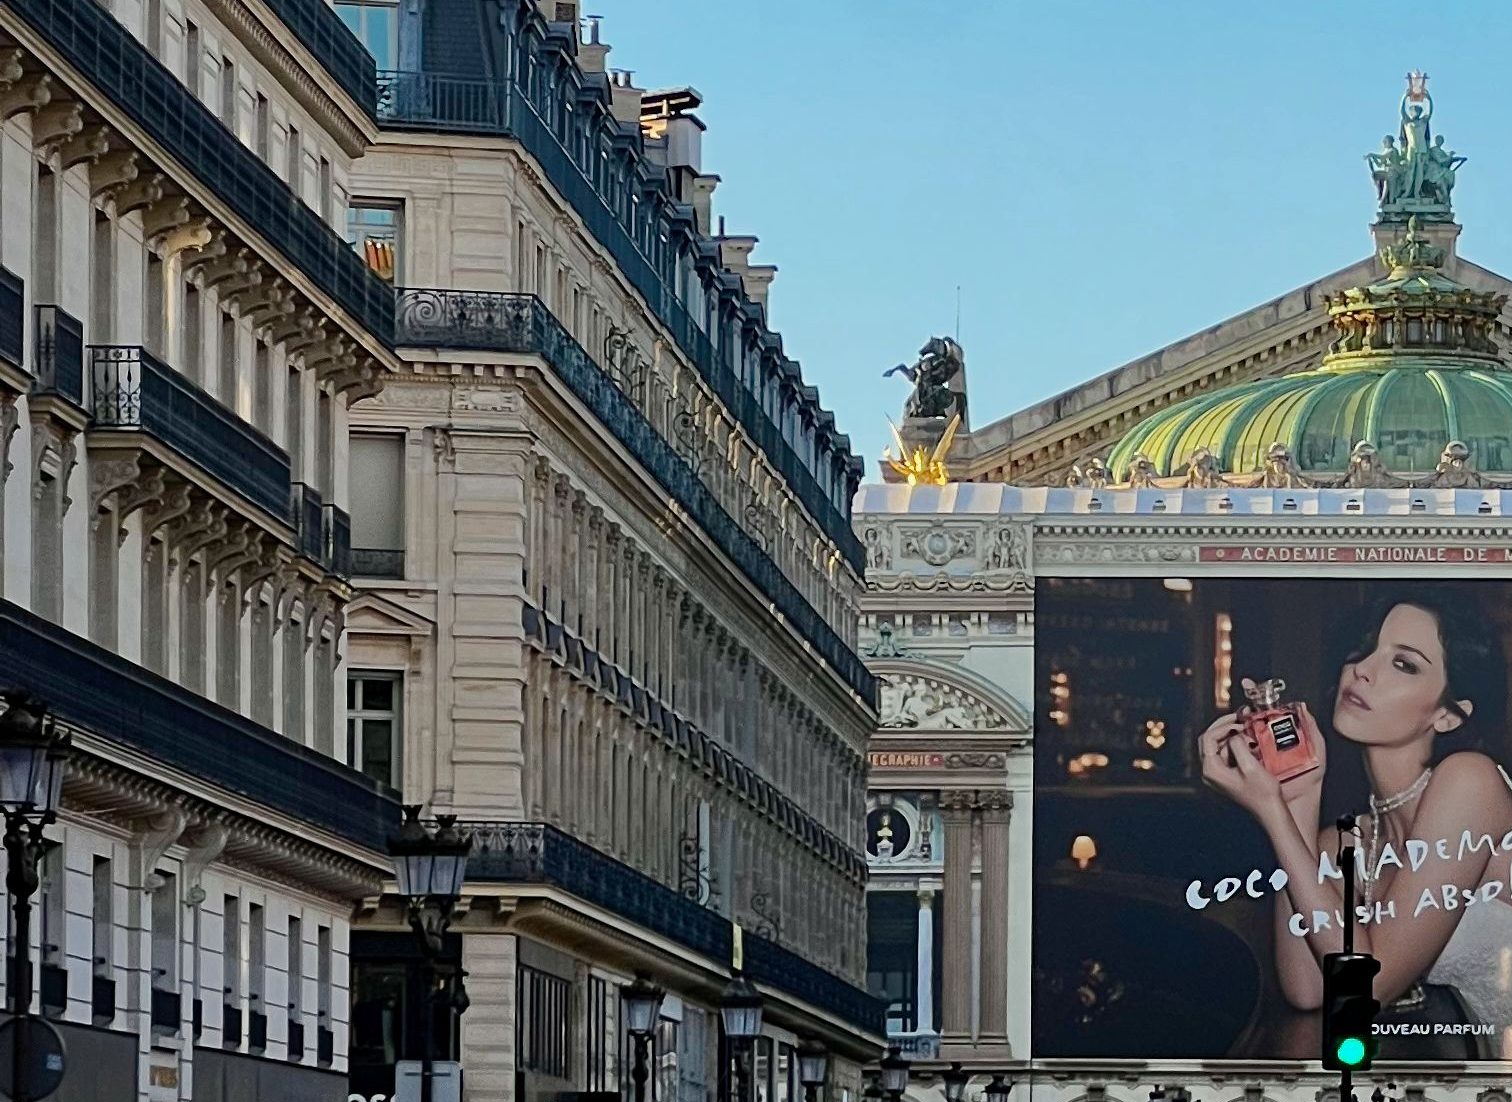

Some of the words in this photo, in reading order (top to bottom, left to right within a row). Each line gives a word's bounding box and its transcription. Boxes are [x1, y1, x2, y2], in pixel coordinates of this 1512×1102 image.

[1241, 547, 1337, 561] ACADEMIE
[1355, 547, 1446, 561] NATIONALE
[1464, 548, 1487, 562] DE
[1186, 868, 1288, 910] COCO
[1371, 1023, 1430, 1035] OUVEAU
[1433, 1024, 1495, 1035] PARFUM
